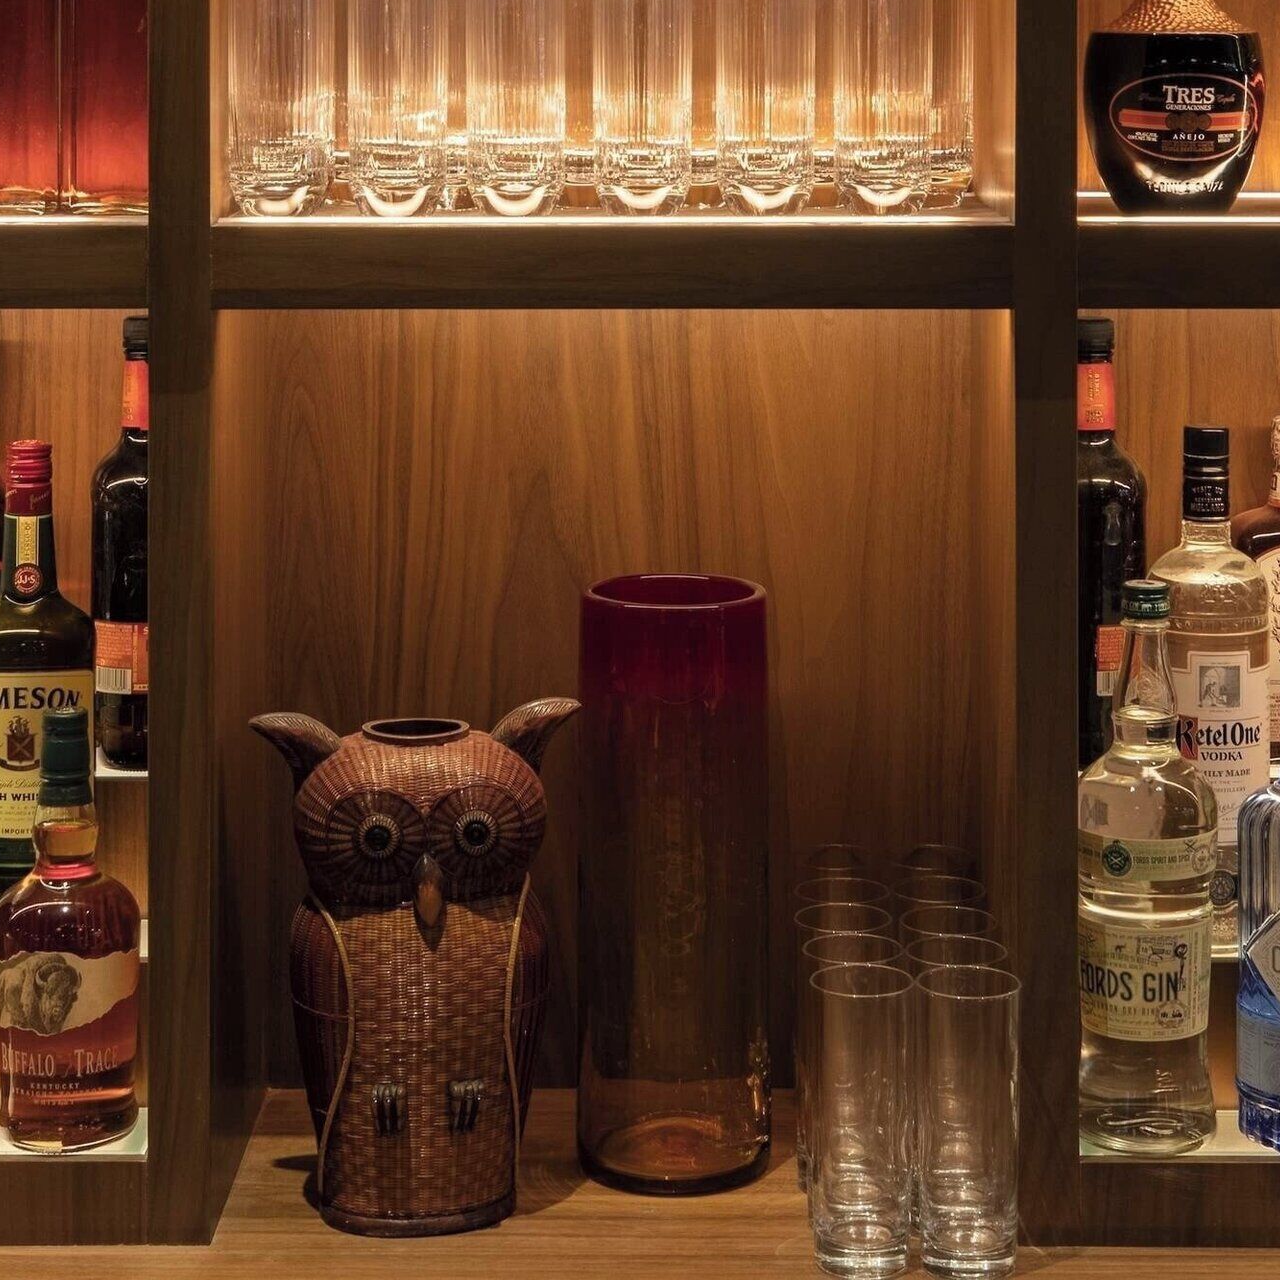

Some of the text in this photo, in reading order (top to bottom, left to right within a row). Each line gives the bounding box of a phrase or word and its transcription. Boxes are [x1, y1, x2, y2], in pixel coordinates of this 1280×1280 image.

[1162, 85, 1215, 104] TRES
[1173, 132, 1205, 141] AÑEJO
[1176, 716, 1260, 759] Ketel One
[1201, 752, 1243, 761] VODKA
[1226, 769, 1250, 778] MADE
[1133, 855, 1177, 865] FORDS SPIRIT AND
[1080, 960, 1179, 1002] FORDS GIN
[1, 1041, 120, 1078] BUFFALO TRACE
